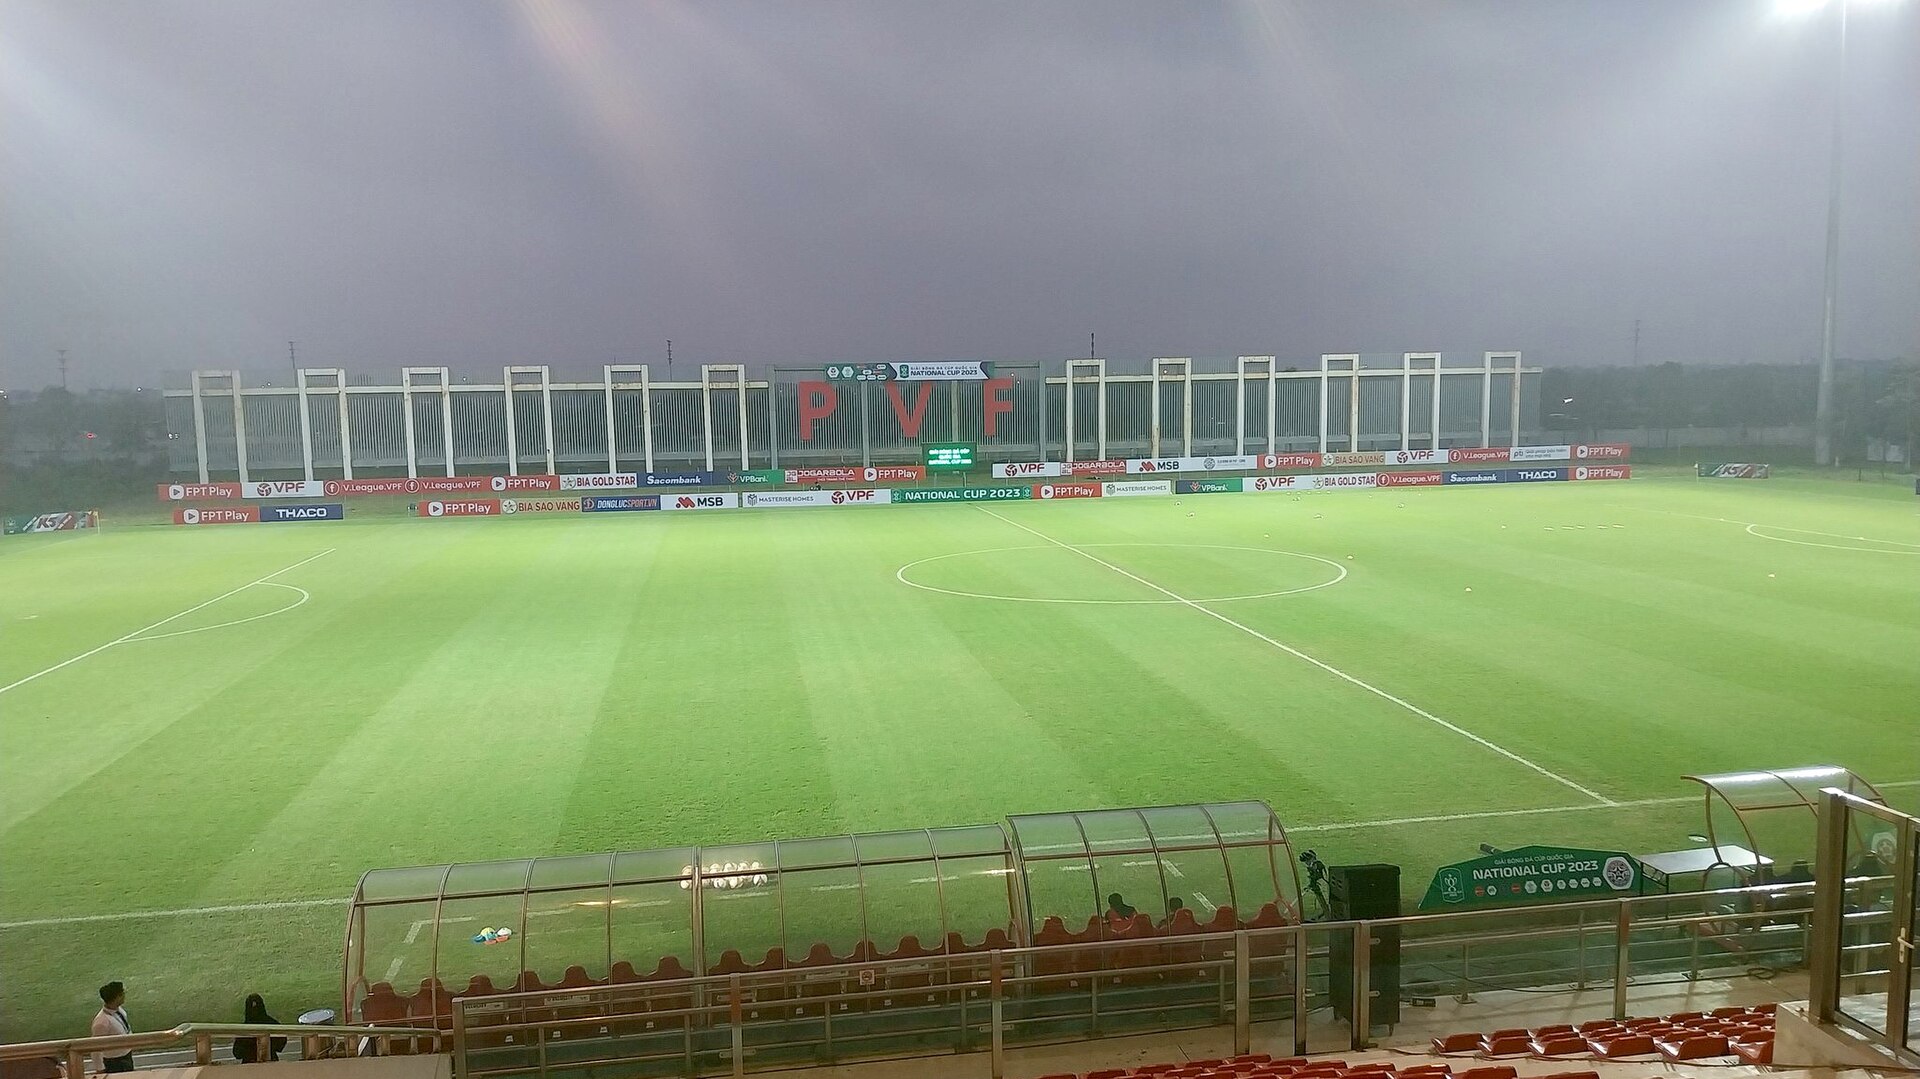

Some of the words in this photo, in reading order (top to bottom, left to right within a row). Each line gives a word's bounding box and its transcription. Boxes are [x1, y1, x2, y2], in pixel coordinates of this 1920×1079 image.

[799, 382, 837, 441] P
[884, 381, 936, 438] V
[984, 378, 1014, 437] F
[1410, 451, 1434, 460] VPF
[1463, 452, 1509, 460] V.League.VPF
[1589, 448, 1604, 456] FPT
[1606, 447, 1623, 457] Play
[1072, 461, 1125, 469] JOGARBOLA
[1278, 457, 1295, 465] FPT
[1297, 456, 1314, 466] Play
[1336, 456, 1347, 464] BIA
[1018, 464, 1045, 473] VPF
[1157, 461, 1179, 470] MSB
[878, 470, 896, 478] FPT
[898, 469, 917, 480] Play
[1451, 474, 1497, 482] Sacombank
[1518, 471, 1557, 479] THACO
[1589, 469, 1605, 477] FPT
[1607, 468, 1623, 478] Play
[577, 477, 590, 486] BIA
[592, 476, 614, 486] GOLD
[616, 476, 636, 485] STAR
[647, 475, 701, 485] Sacombank
[740, 475, 768, 483] VPBank
[1269, 477, 1296, 487] VPF
[1325, 478, 1336, 486] BIA
[1338, 477, 1356, 485] GOLD
[1358, 476, 1376, 484] STAR
[1392, 475, 1440, 484] V.League.VPF
[274, 482, 305, 492] VPF
[344, 483, 402, 493] V.League.VPF
[423, 481, 481, 490] V.League.VPF
[508, 479, 528, 488] FPT
[529, 479, 551, 490] Play
[186, 487, 207, 497] FPT
[209, 486, 232, 498] Play
[846, 491, 875, 500] VPF
[905, 490, 960, 500] NATIONAL
[964, 490, 986, 498] CUP
[990, 489, 1020, 498] 2023
[1055, 487, 1072, 496] FPT
[1074, 486, 1093, 496] Play
[519, 502, 533, 512] BIA
[536, 502, 554, 511] SAO
[697, 497, 723, 507] MSB
[276, 508, 327, 518] THACO
[445, 503, 466, 513] FPT
[468, 503, 491, 514] Play
[202, 511, 223, 521] FPT
[225, 510, 249, 522] Play
[1473, 865, 1539, 880] NATIONAL
[1541, 863, 1566, 874] CUP
[1568, 860, 1599, 872] 2023
